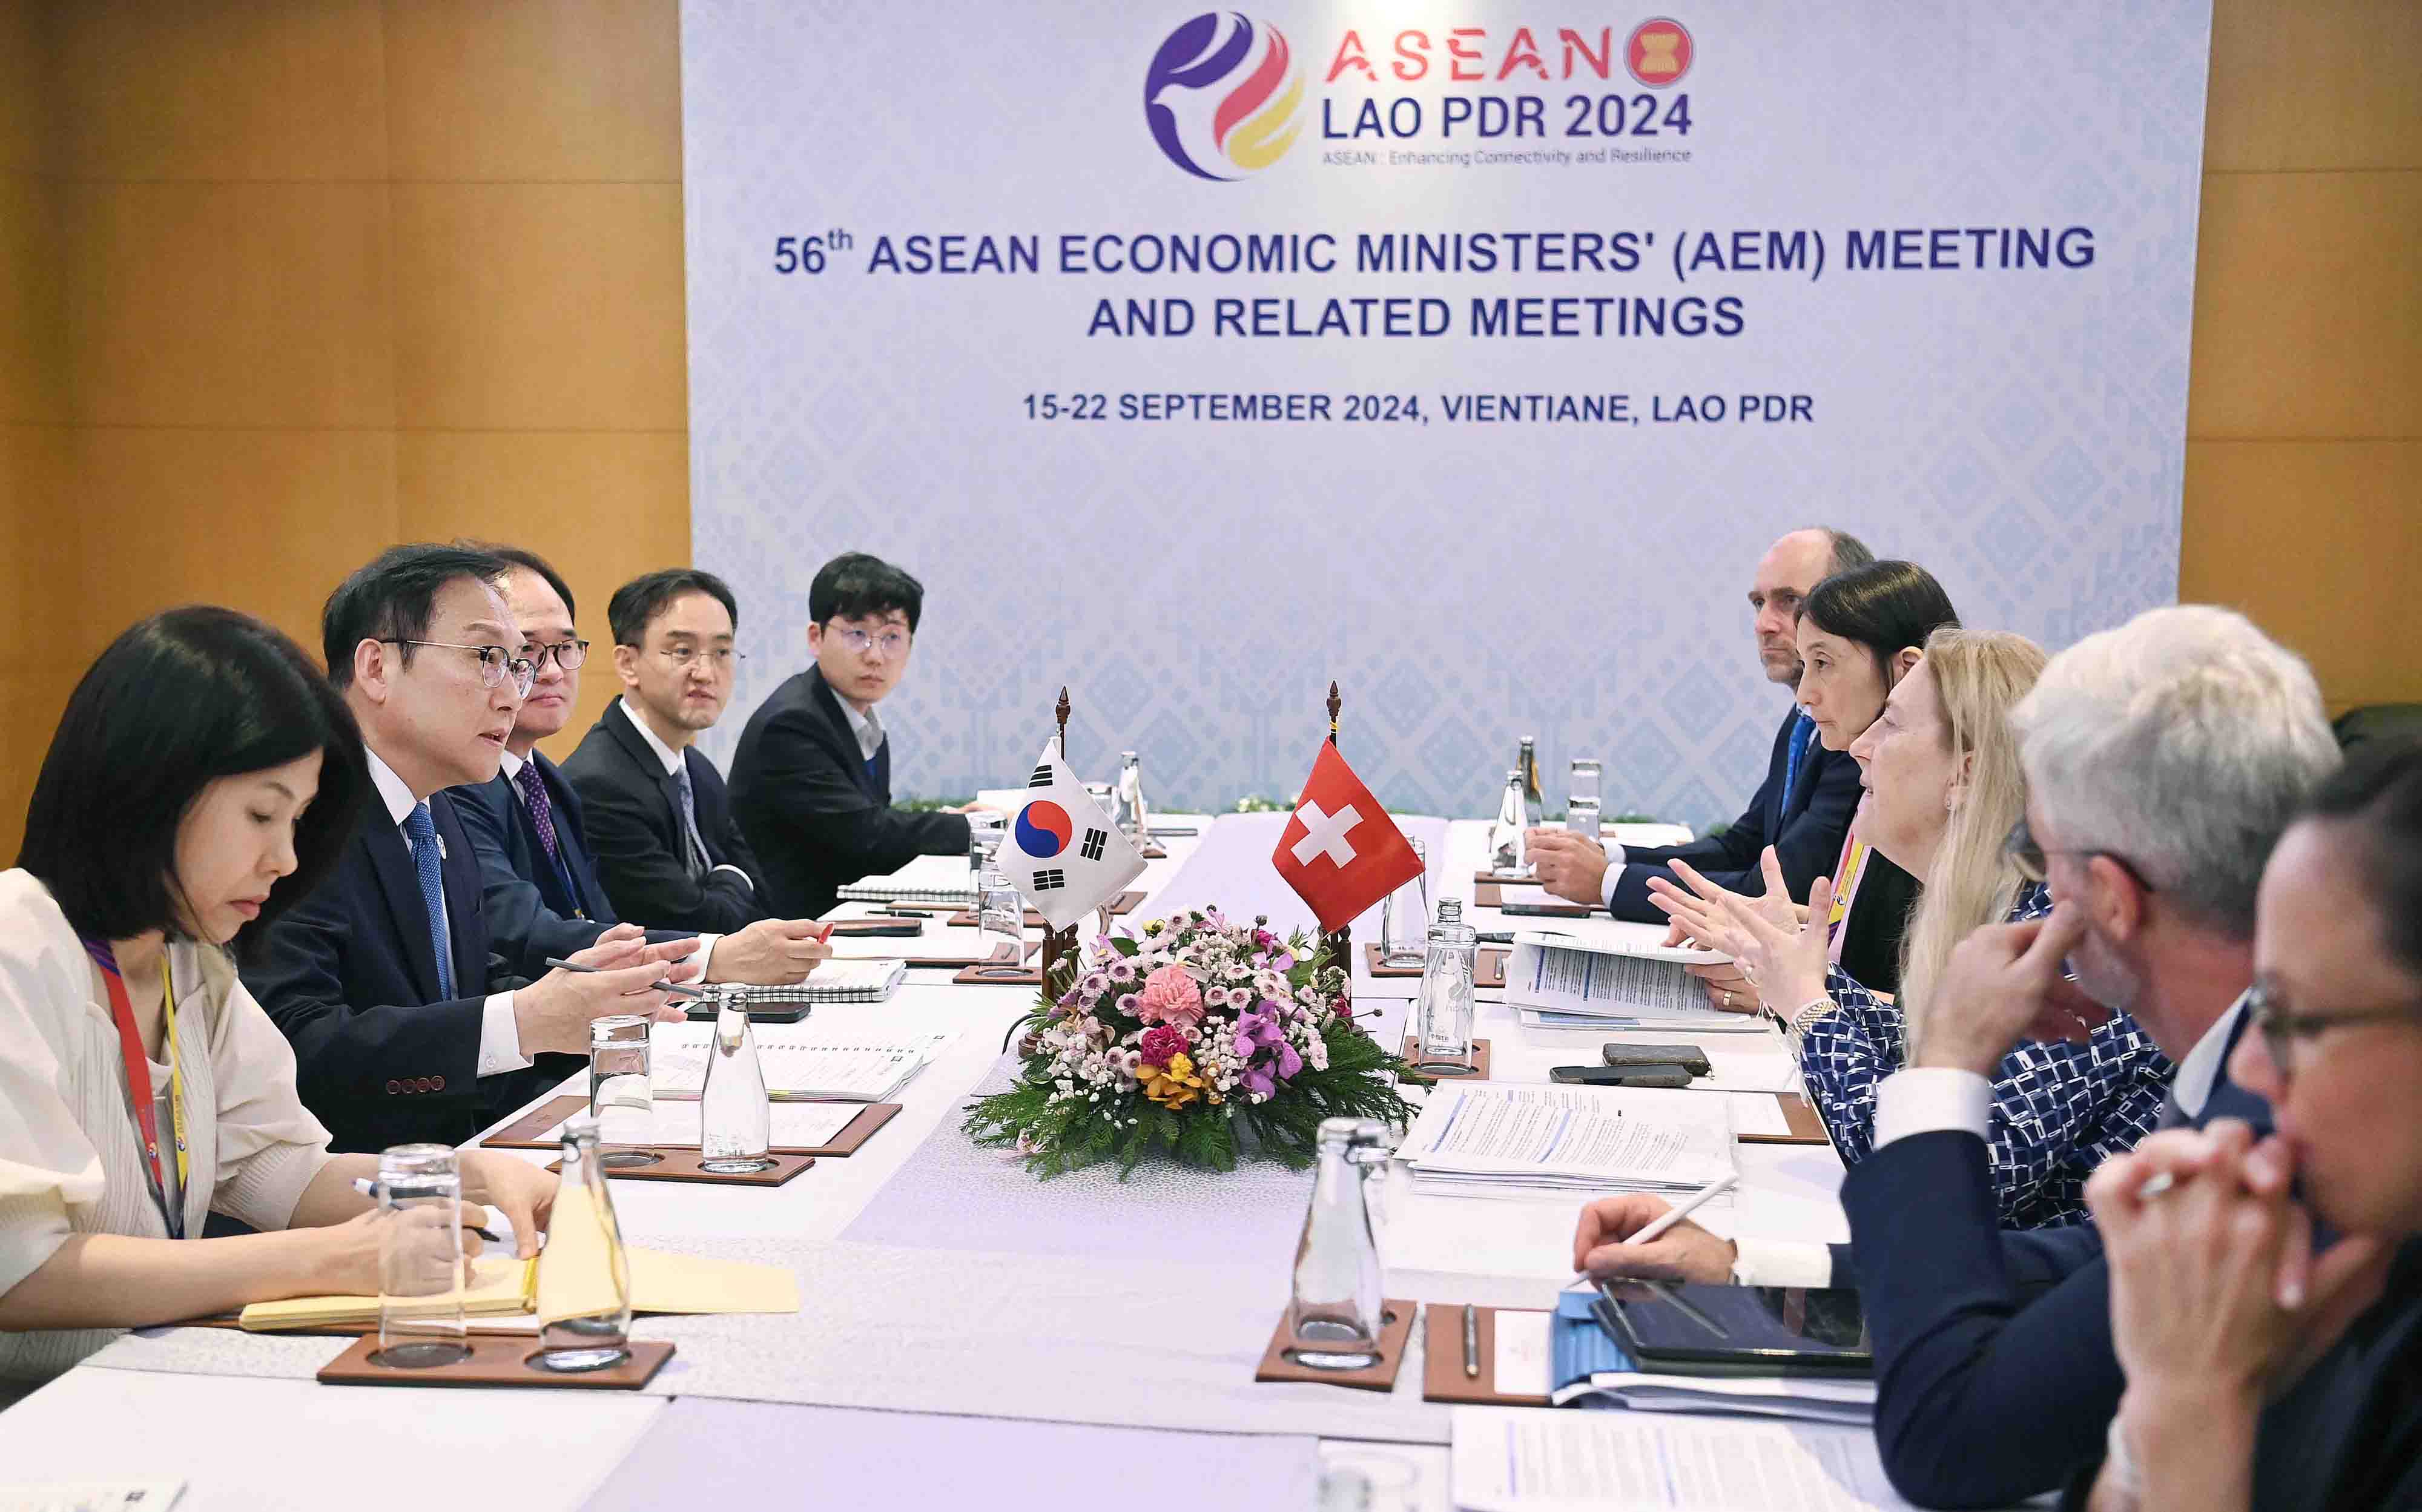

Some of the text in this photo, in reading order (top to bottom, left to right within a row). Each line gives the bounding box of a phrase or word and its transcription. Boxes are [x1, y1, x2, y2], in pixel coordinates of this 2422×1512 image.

[1326, 28, 1612, 83] ASEAN
[1323, 94, 1692, 140] LAO PDR 2024
[1324, 151, 1376, 165] ASEAN
[1389, 151, 1470, 168] Enhancing
[1474, 150, 1571, 167] Connectivity
[1577, 149, 1606, 163] and
[1611, 147, 1692, 163] Resilience
[775, 227, 2095, 283] 56th ASEAN ECONOMIC MINISTERS' (AEM) MEETING
[1088, 297, 1745, 338] AND RELATED MEETINGS
[1024, 394, 1813, 427] 15-22 SEPTEMBER 2024, VIENTIANE, LAO PDR
